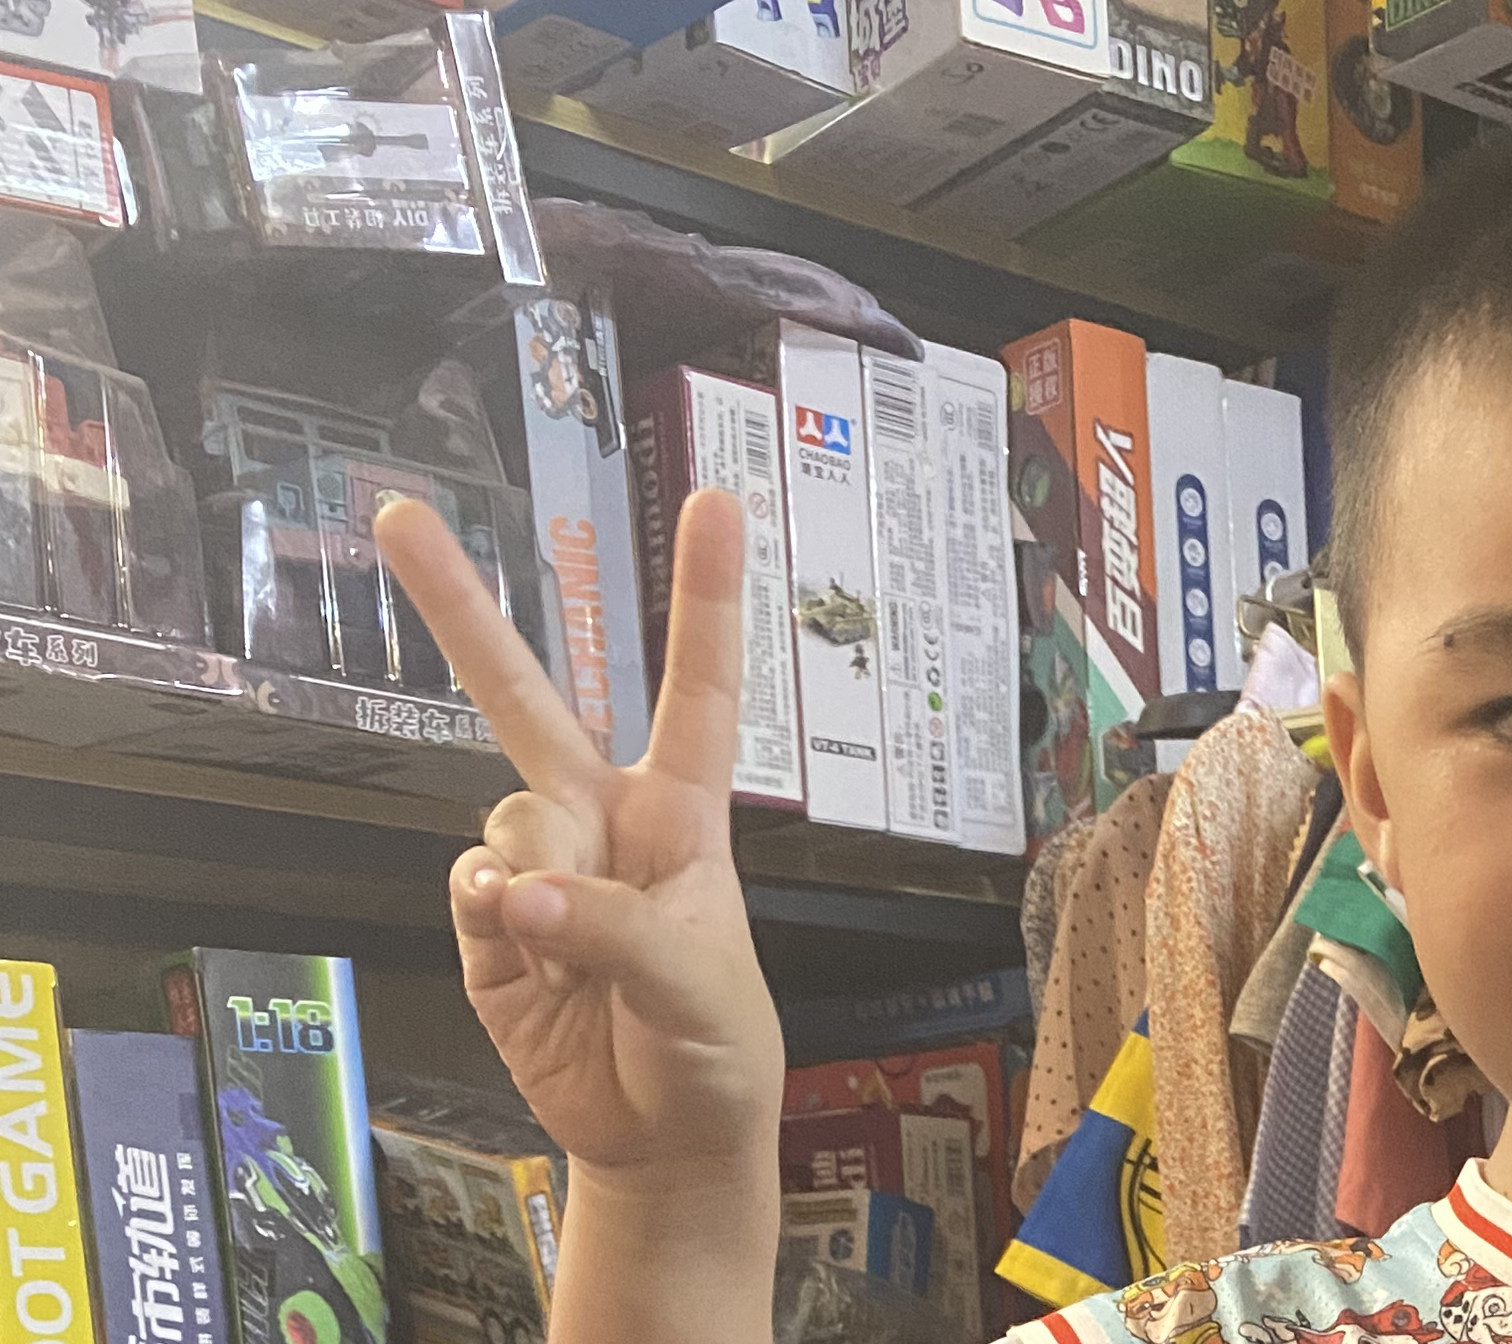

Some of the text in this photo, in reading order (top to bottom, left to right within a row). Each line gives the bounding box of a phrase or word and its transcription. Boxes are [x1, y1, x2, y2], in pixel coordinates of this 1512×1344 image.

[1109, 38, 1202, 100] DINO
[393, 207, 430, 227] DIY
[227, 995, 336, 1054] 1:18
